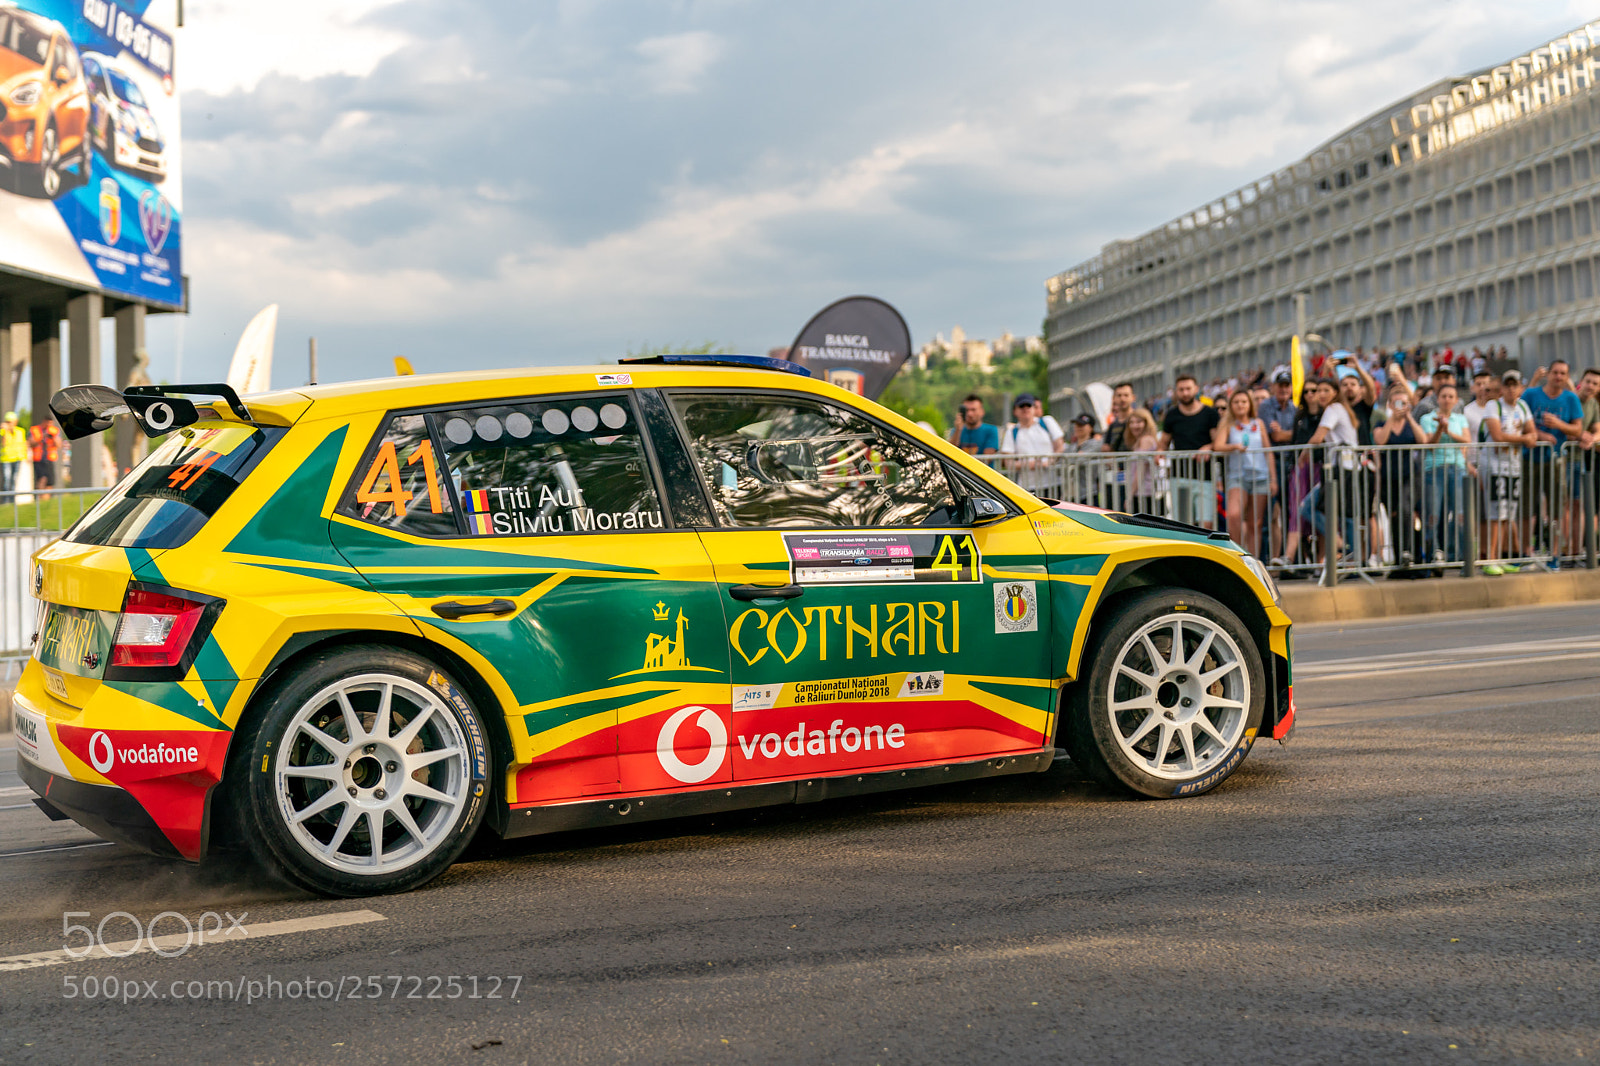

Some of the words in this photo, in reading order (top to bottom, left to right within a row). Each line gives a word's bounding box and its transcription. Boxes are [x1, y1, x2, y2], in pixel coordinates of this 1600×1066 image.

[825, 333, 869, 347] BANCA
[800, 346, 891, 363] TRANSILVANIA
[167, 450, 223, 491] 41
[356, 439, 443, 516] 41
[491, 486, 531, 509] Titi
[538, 484, 583, 508] Aur
[493, 511, 562, 534] Silviu
[571, 507, 663, 531] Moraru
[931, 534, 978, 581] 41
[744, 691, 762, 699] MTS
[795, 677, 850, 694] Campionatul
[852, 676, 888, 691] Național
[795, 693, 806, 704] de
[807, 690, 836, 703] Raliuri
[838, 688, 867, 701] Dunlop
[869, 687, 890, 698] 2018
[452, 694, 487, 777] MICHELIN
[738, 719, 905, 760] vodafone
[117, 743, 199, 764] vodafone
[1179, 750, 1241, 794] MICHELIN
